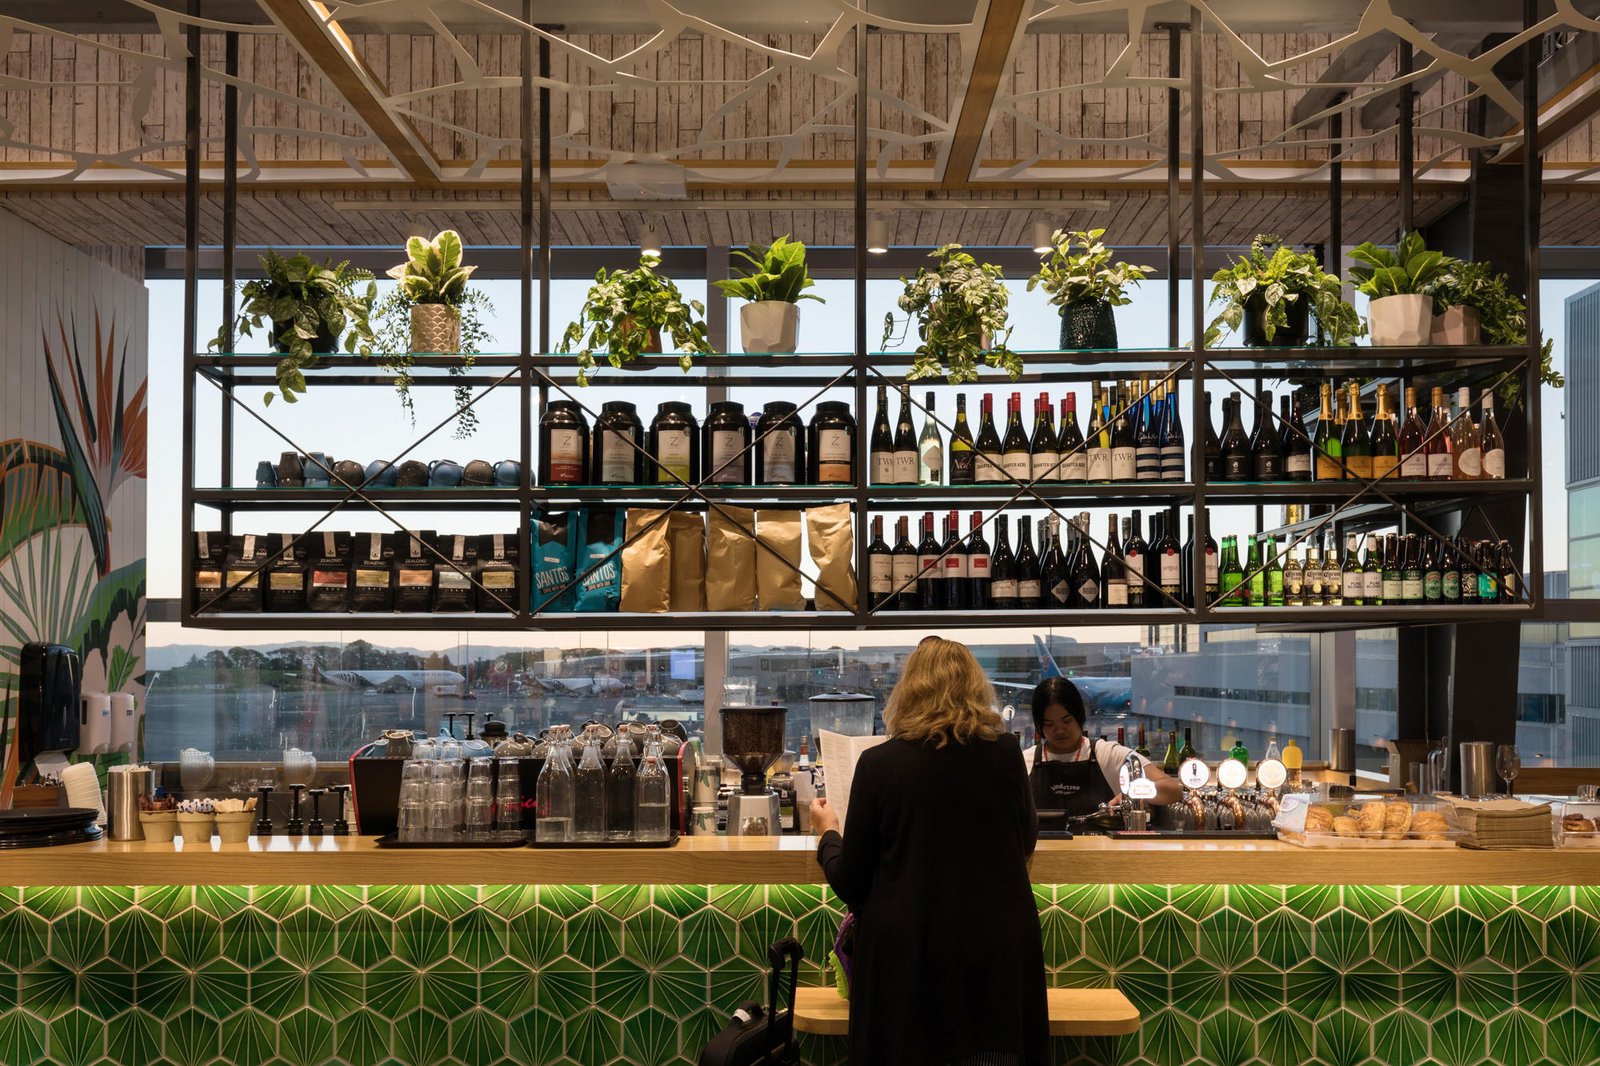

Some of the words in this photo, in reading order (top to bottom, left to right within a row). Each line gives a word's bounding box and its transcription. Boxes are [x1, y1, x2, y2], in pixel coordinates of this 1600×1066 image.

[896, 456, 915, 465] TWR
[1088, 453, 1108, 462] TWR
[1114, 452, 1133, 462] TWR
[535, 566, 570, 589] SANTOS
